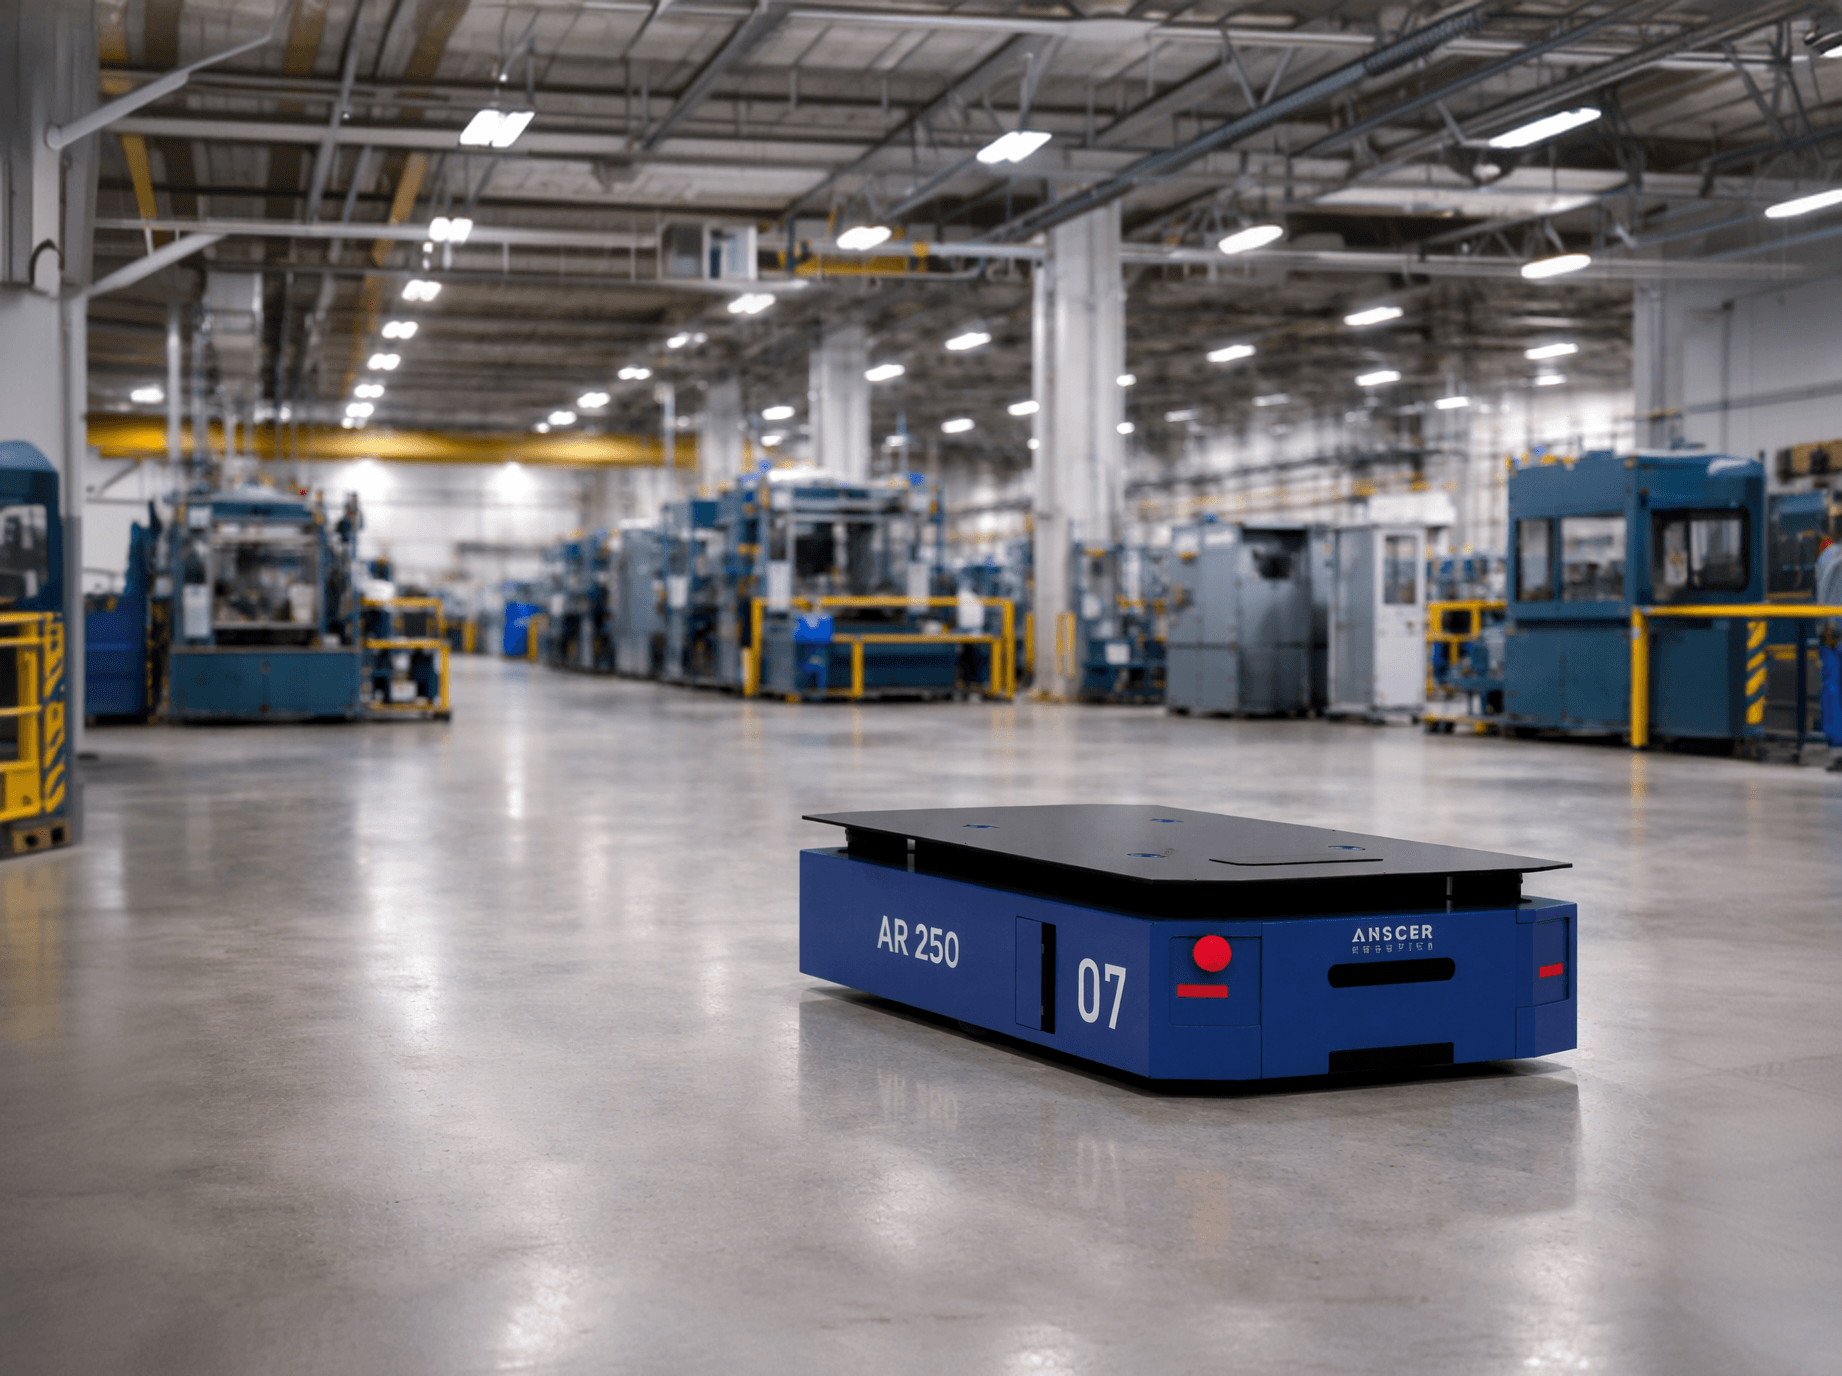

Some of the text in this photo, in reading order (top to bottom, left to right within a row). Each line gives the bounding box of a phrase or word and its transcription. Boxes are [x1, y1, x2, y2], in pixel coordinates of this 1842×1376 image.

[877, 915, 960, 969] AR 250
[1351, 924, 1433, 943] ANSCER
[1077, 957, 1127, 1030] 07
